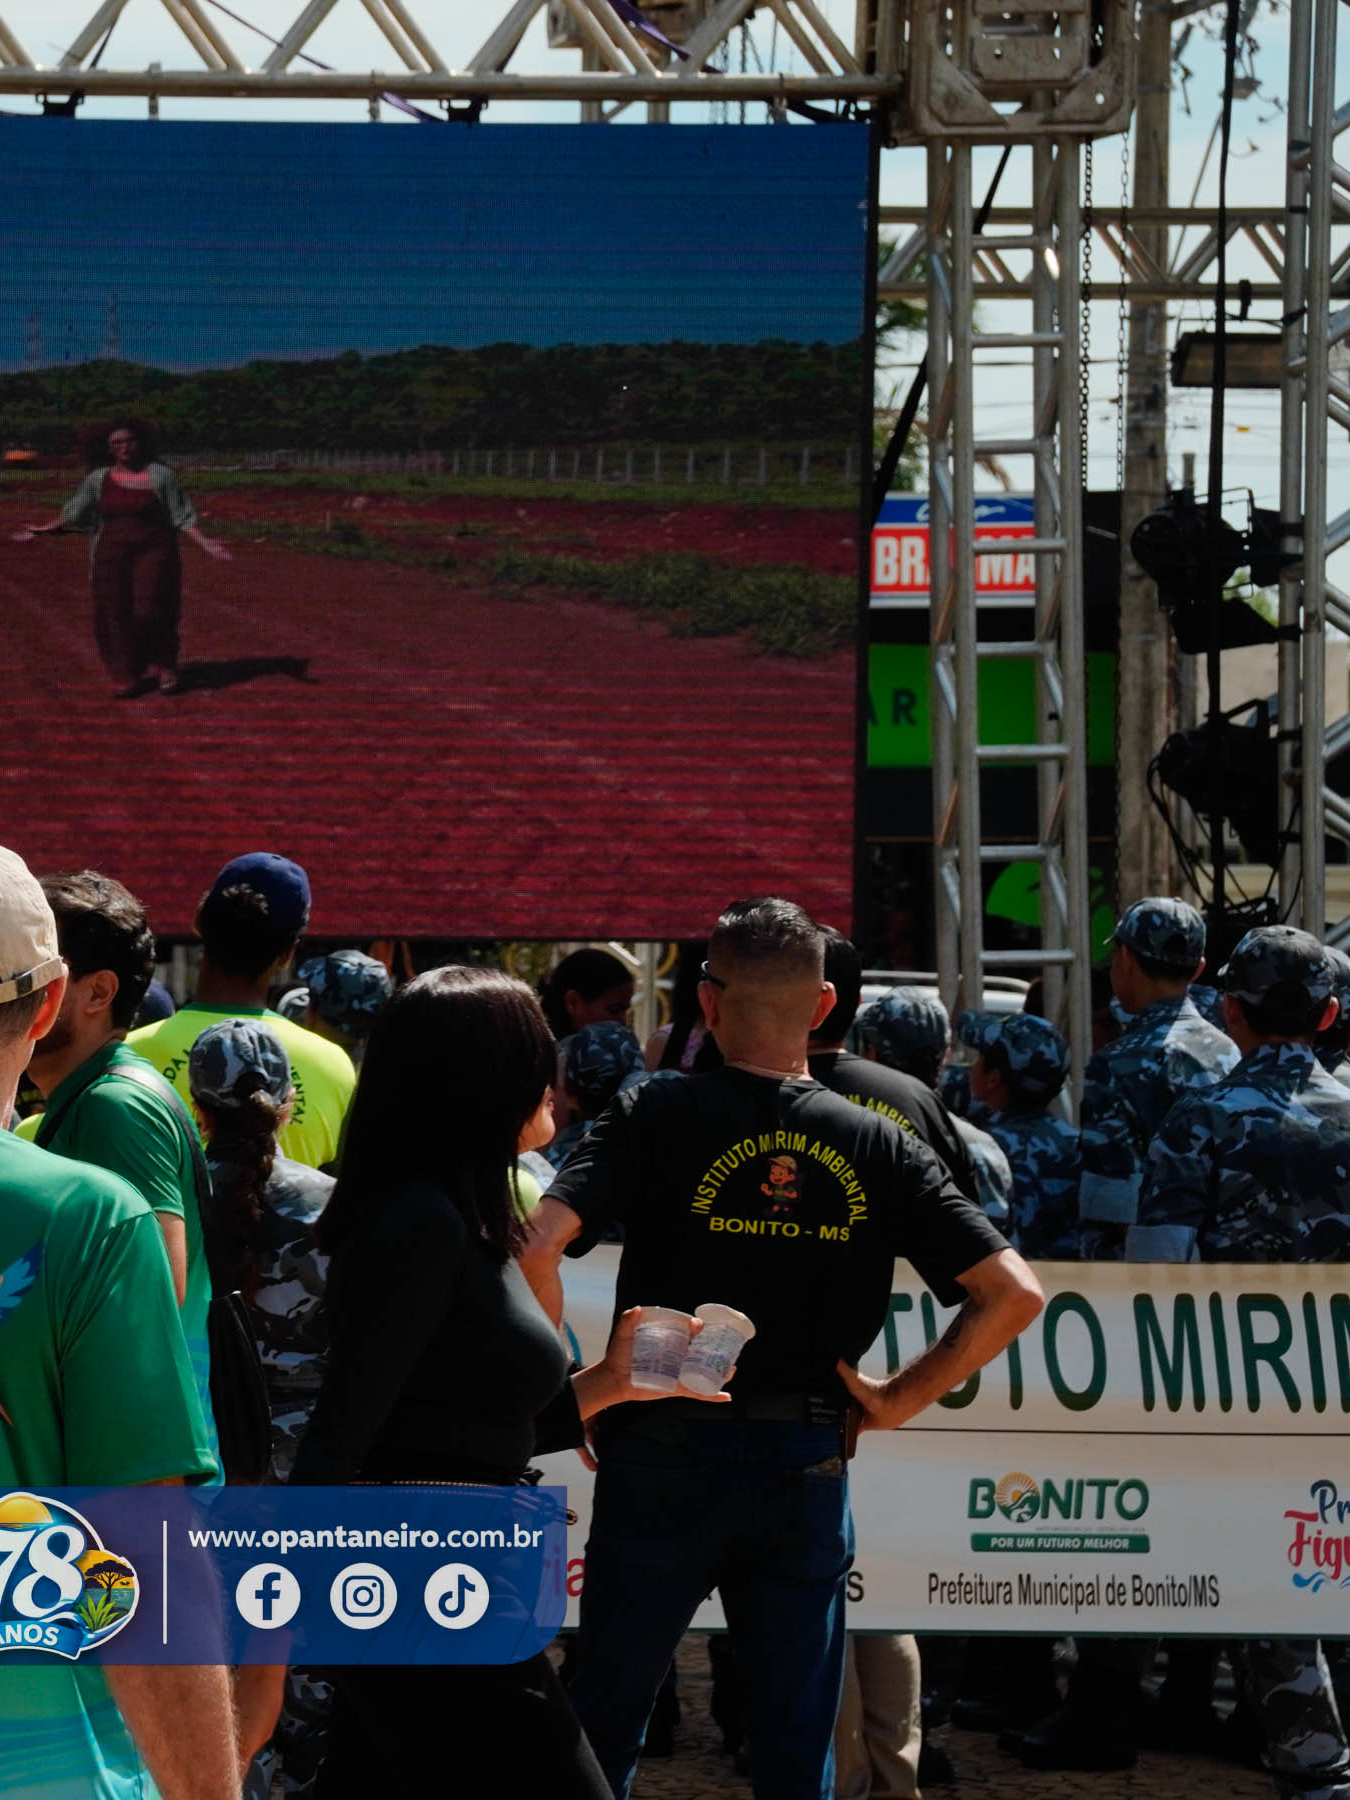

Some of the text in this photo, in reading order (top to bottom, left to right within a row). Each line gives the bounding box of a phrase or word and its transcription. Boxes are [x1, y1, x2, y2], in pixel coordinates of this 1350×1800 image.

[874, 535, 1036, 586] BRMA
[690, 1130, 868, 1225] INSTITUTO MIRIM AMBIENTAL
[709, 1217, 800, 1238] BONITO
[818, 1224, 850, 1242] MS
[1133, 1291, 1350, 1413] MIRI
[990, 1537, 1130, 1550] POR UM FUTURO MELHOR
[929, 1573, 1220, 1614] Prefeitura Municipal de Bonito/MS
